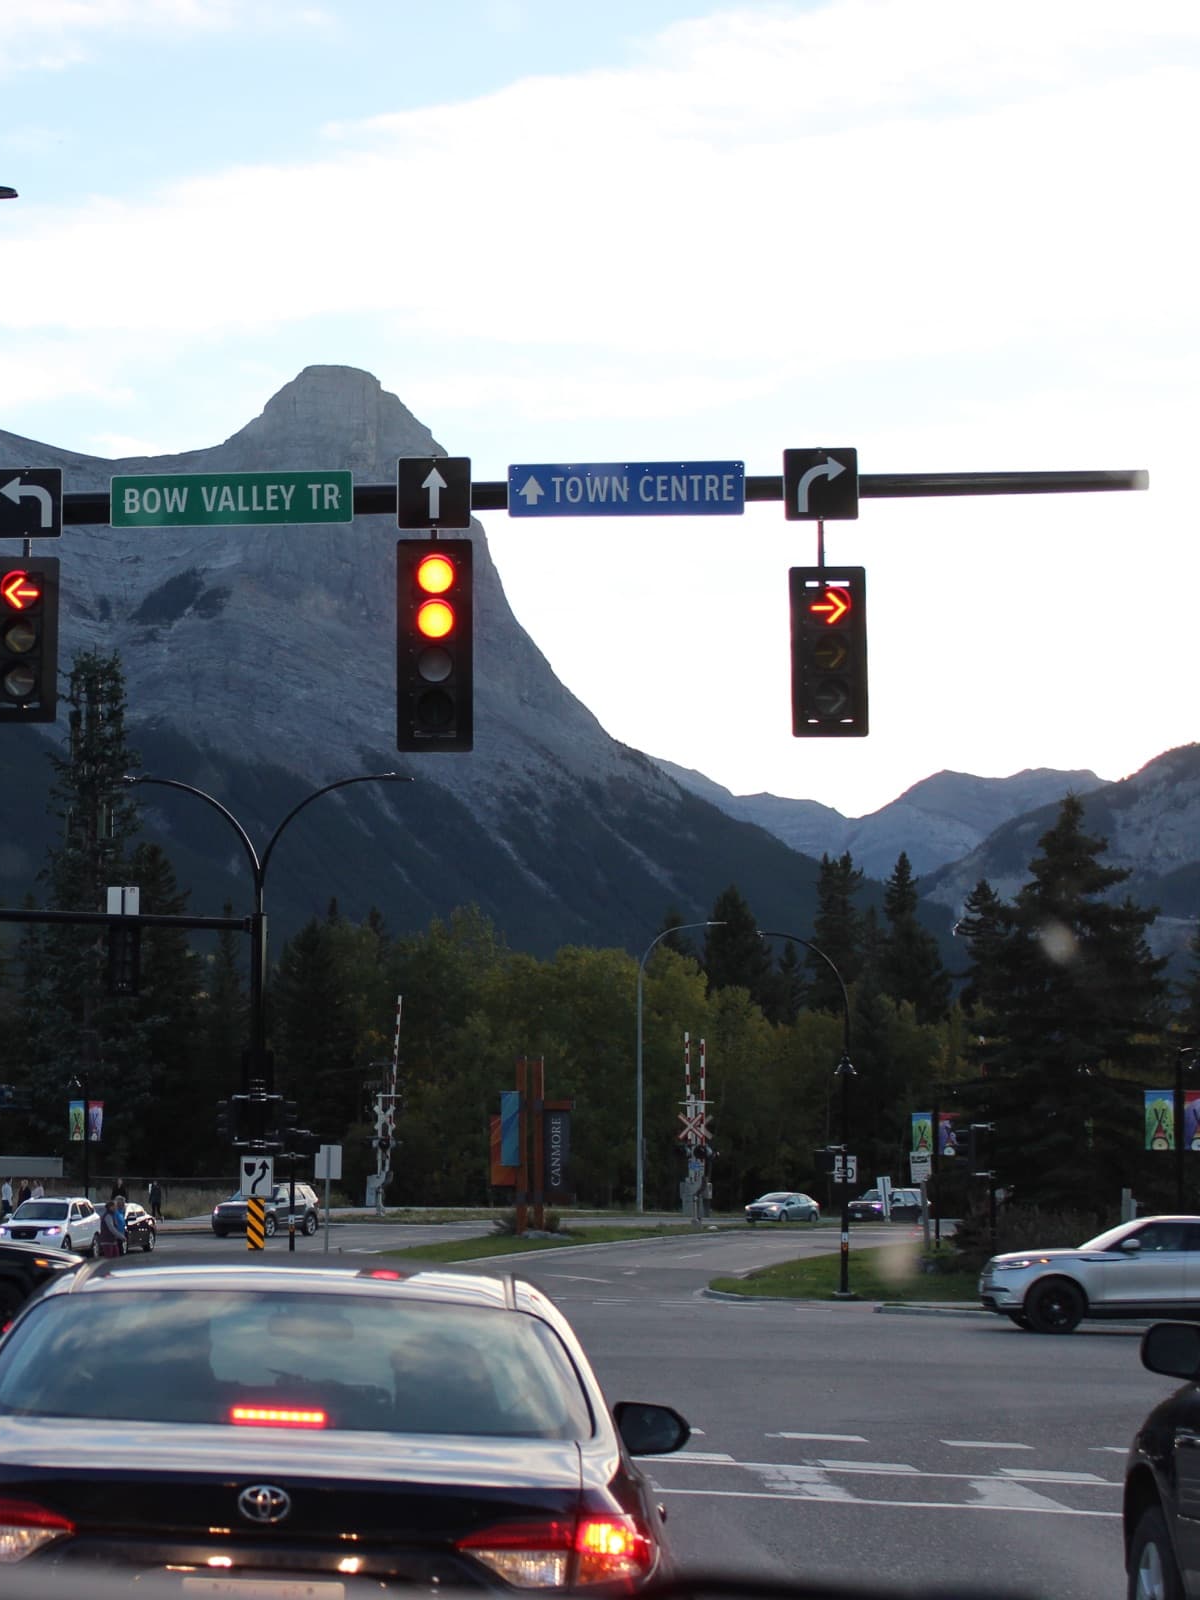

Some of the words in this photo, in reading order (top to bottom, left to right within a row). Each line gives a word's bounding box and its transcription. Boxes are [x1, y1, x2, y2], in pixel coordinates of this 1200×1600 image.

[123, 487, 188, 514] BOW
[201, 484, 296, 512] VALLEY
[307, 483, 340, 510] TR
[551, 476, 628, 503] TOWN
[639, 475, 735, 502] CENTRE
[551, 1117, 561, 1187] CANMORE
